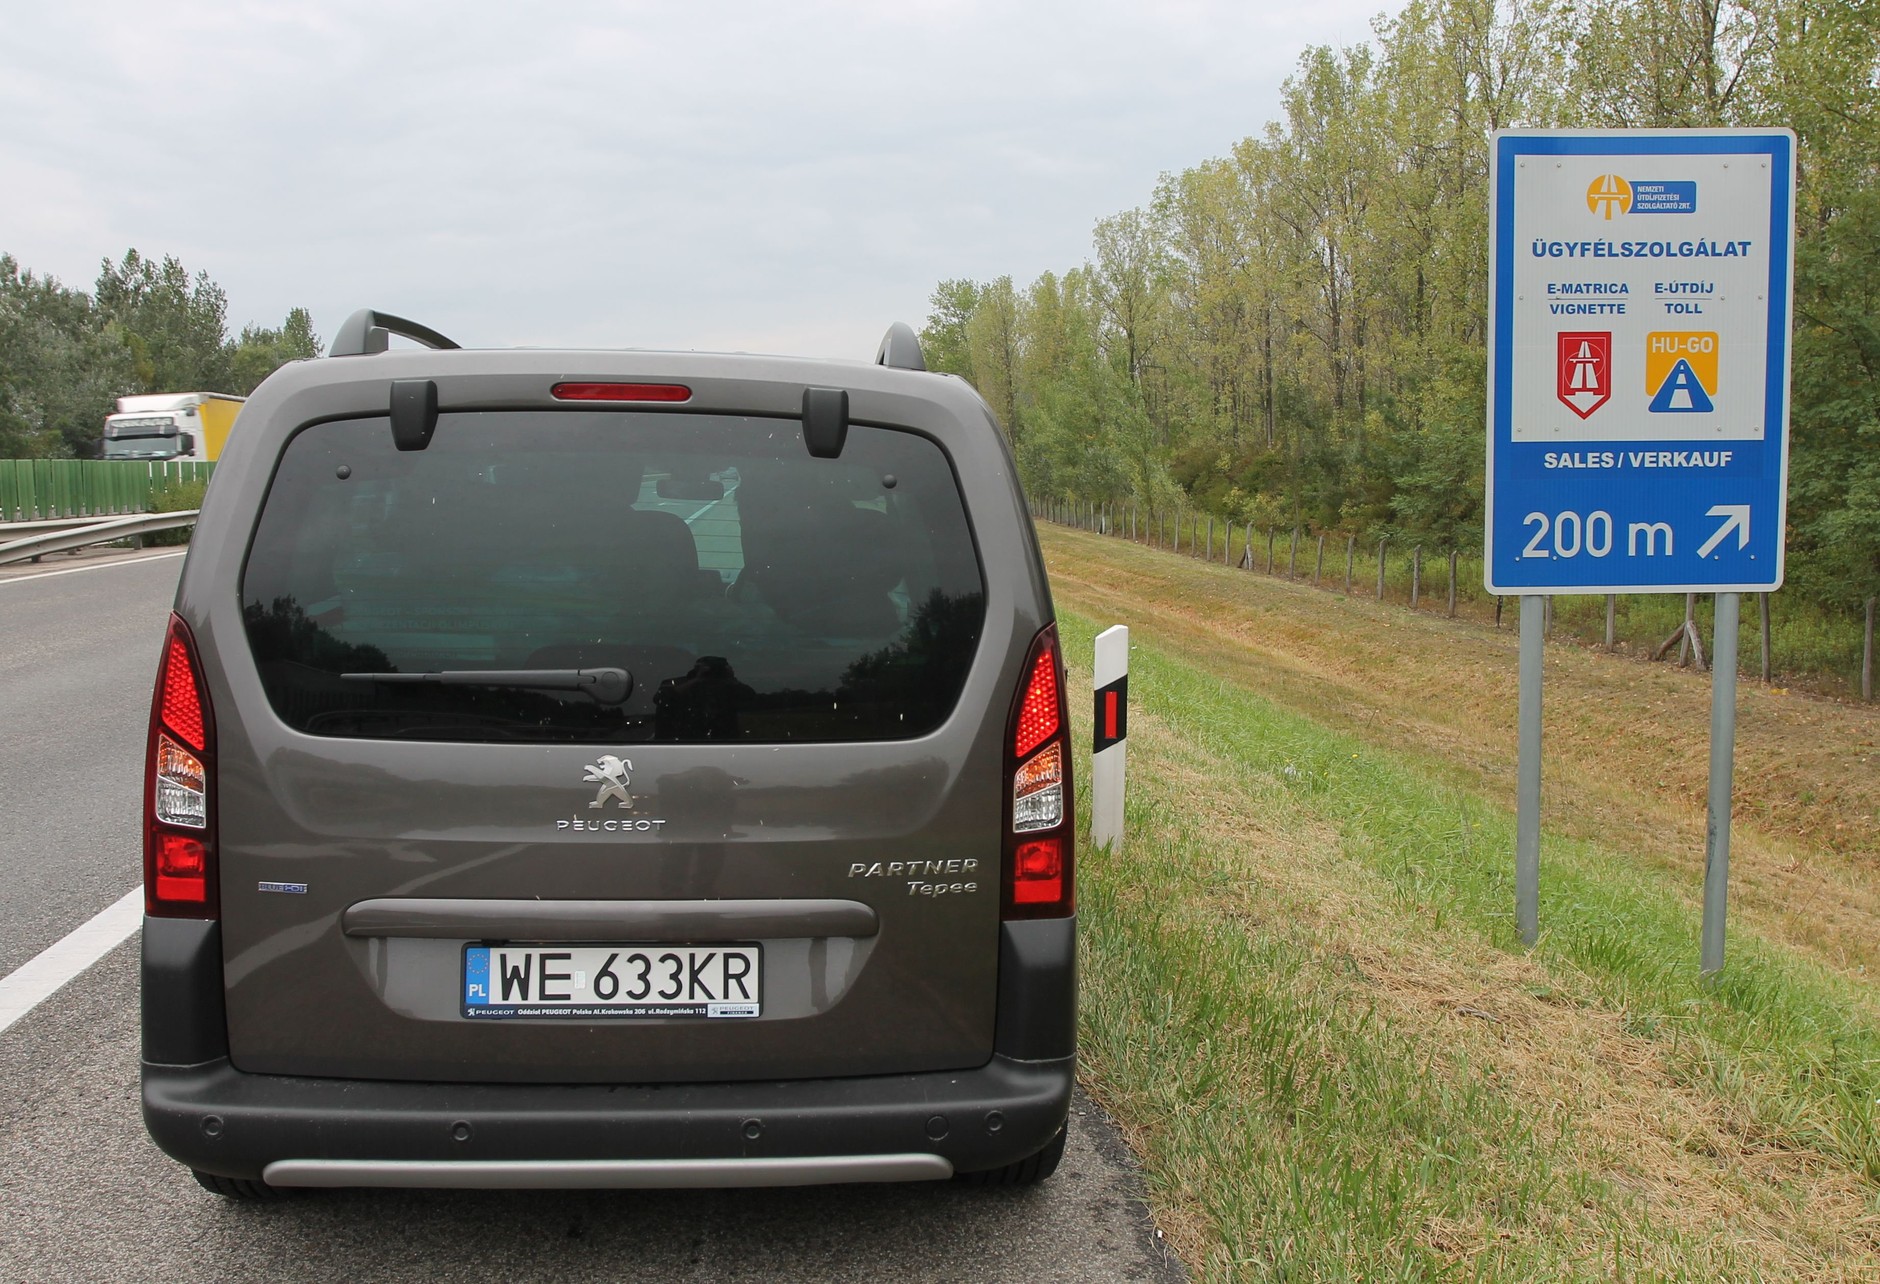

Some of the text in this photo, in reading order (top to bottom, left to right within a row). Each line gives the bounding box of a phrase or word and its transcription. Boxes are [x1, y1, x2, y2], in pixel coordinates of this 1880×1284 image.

[1637, 185, 1664, 193] NEMZETI
[1637, 193, 1680, 201] ÚTDÍJFIZETÉSI
[1637, 201, 1678, 209] SZOLGÁLTATÓ
[1532, 238, 1751, 257] ÜGYFÉLSZOLGÁLAT
[1547, 283, 1629, 294] E-MATRICA
[1654, 280, 1714, 294] E-ÚTDÍJ
[1550, 303, 1626, 314] VIGNETTE
[1664, 303, 1703, 314] TOLL
[1651, 337, 1714, 354] HU-GO
[1522, 510, 1674, 559] 200 m
[556, 818, 666, 832] PEUGEOT
[848, 858, 979, 878] PARTNER
[907, 881, 978, 898] Tepee
[500, 952, 751, 1001] WE 633KR
[468, 984, 487, 997] PL
[572, 1008, 592, 1016] Polska
